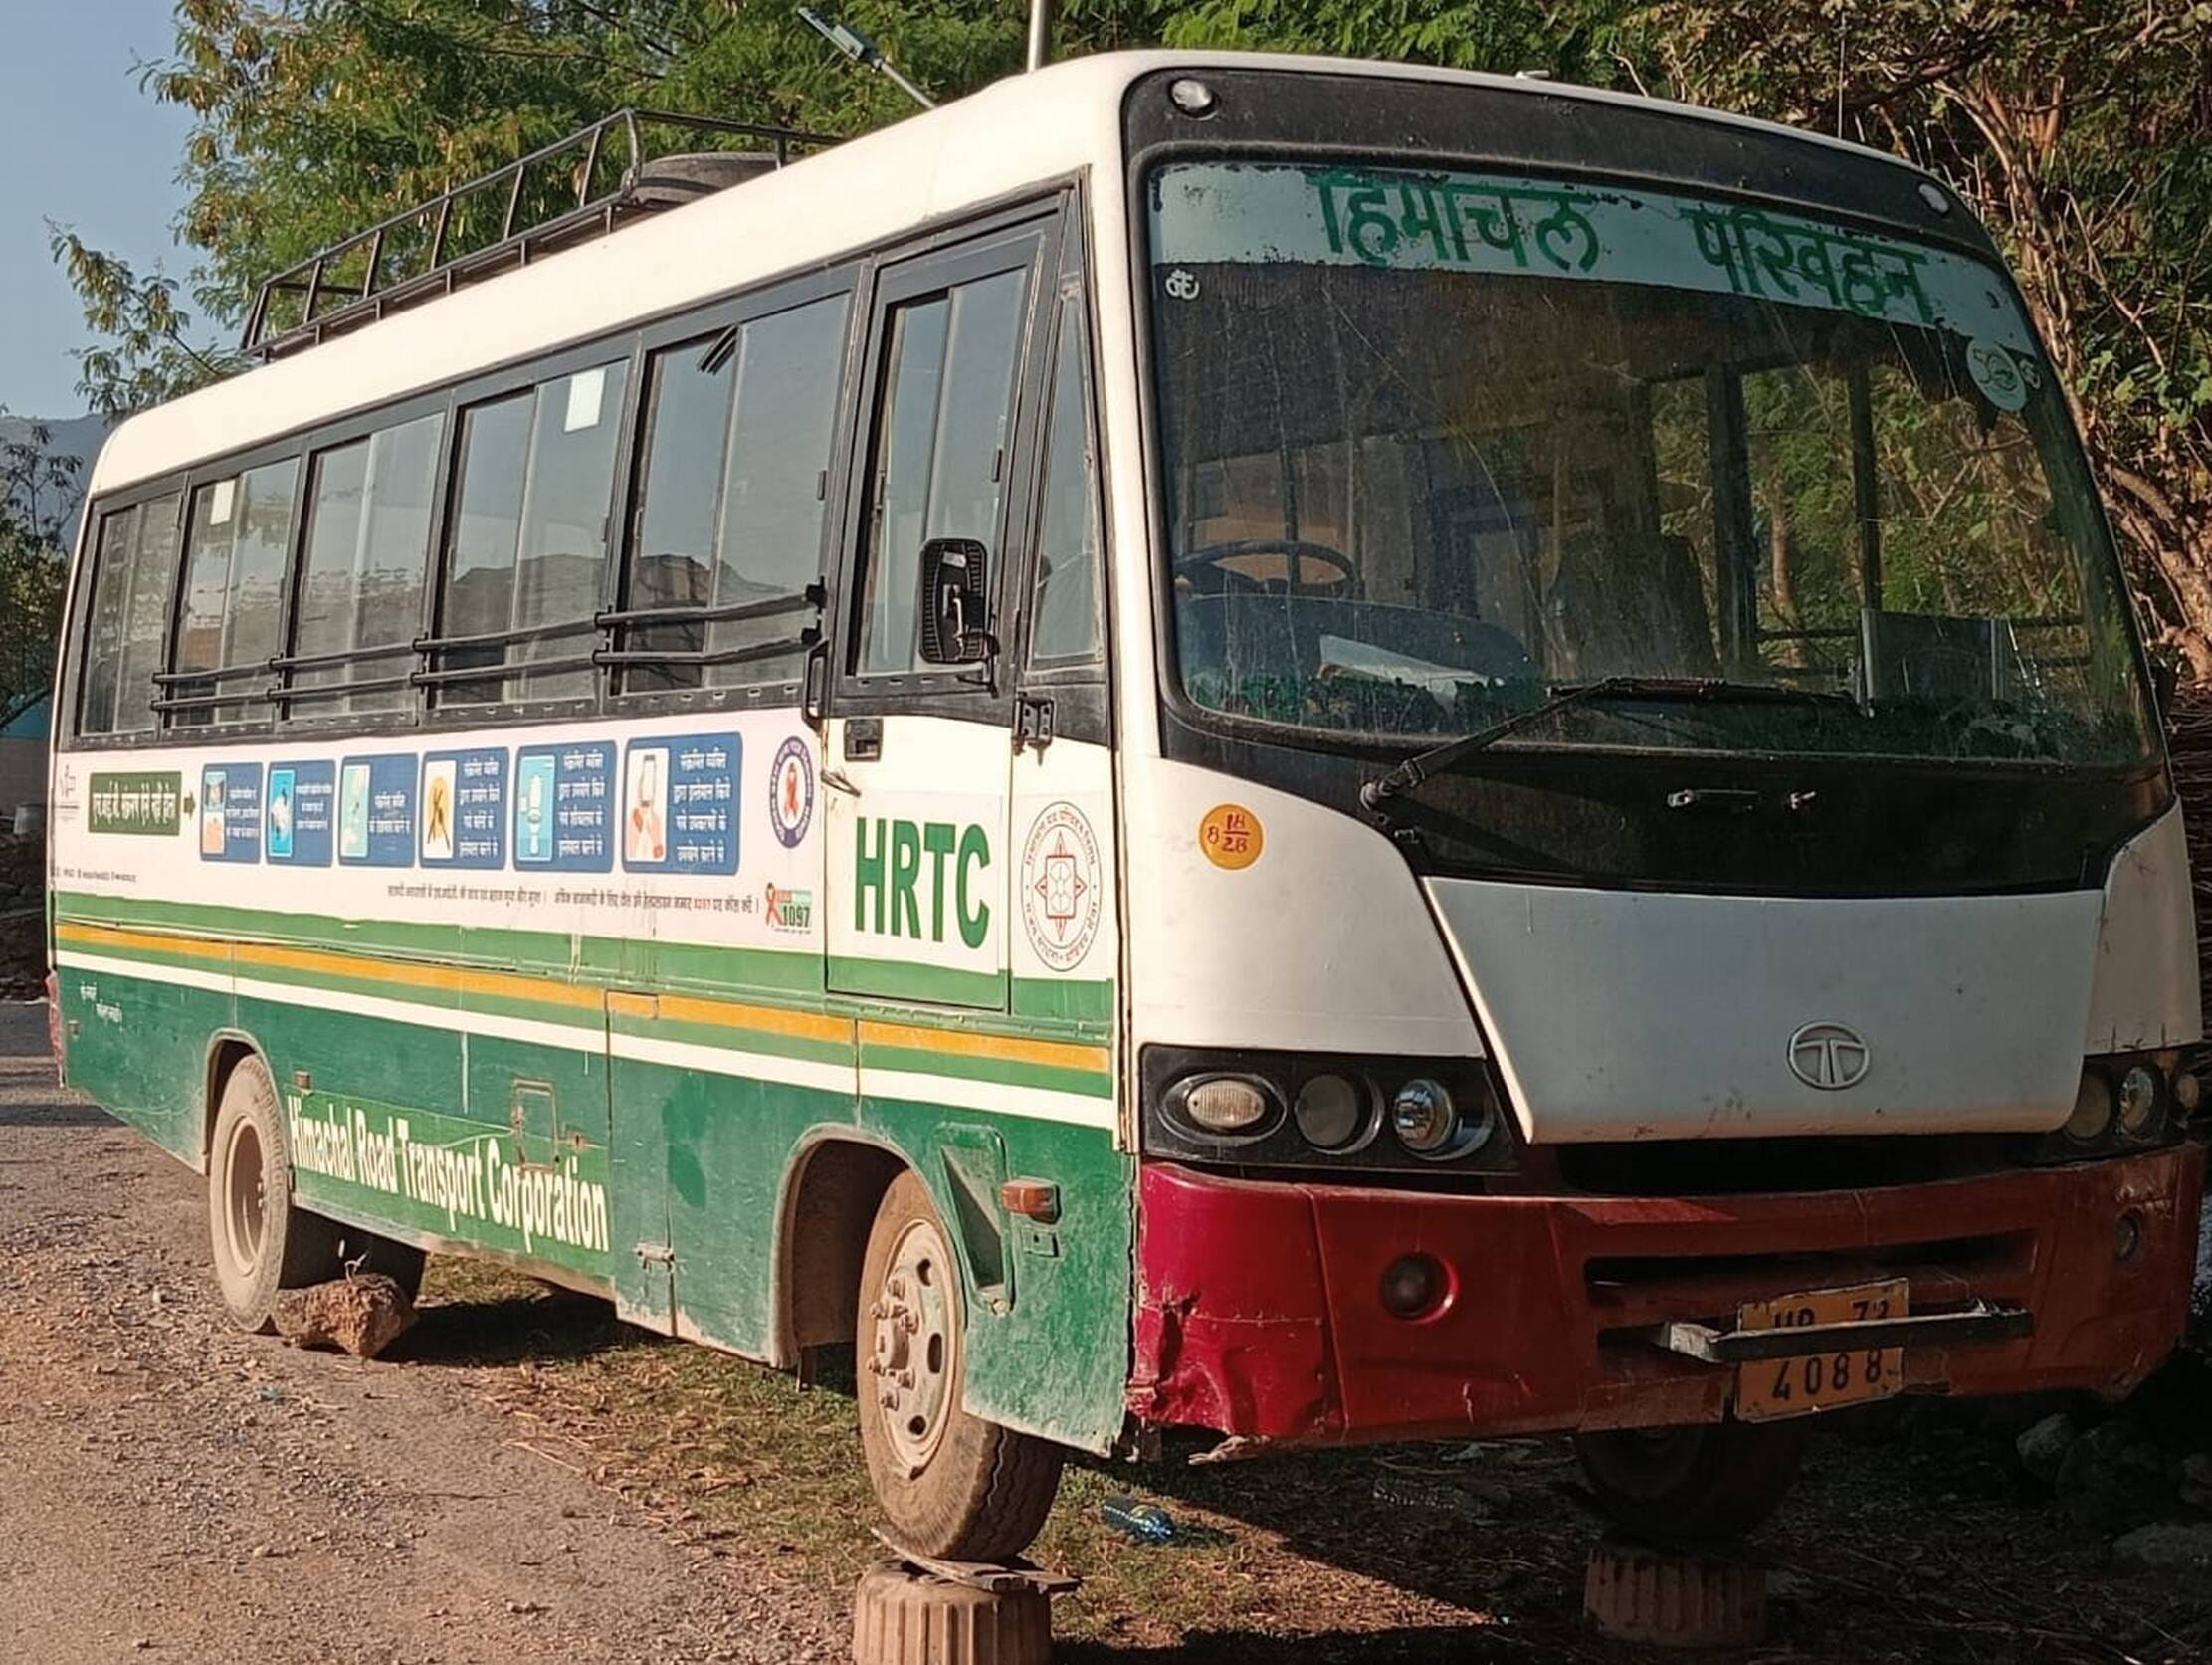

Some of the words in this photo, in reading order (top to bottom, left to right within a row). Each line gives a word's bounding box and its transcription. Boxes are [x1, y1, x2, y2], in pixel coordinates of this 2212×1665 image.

[1306, 166, 1598, 271] हिमाचल
[1679, 205, 1934, 324] परिवहन
[783, 905, 811, 928] 1097
[855, 816, 991, 948] HRTC
[287, 1095, 356, 1182] Himachal
[354, 1108, 399, 1194] Road
[396, 1118, 486, 1232] Transport
[488, 1138, 609, 1254] Corporation
[1772, 1349, 1883, 1401] 4088
